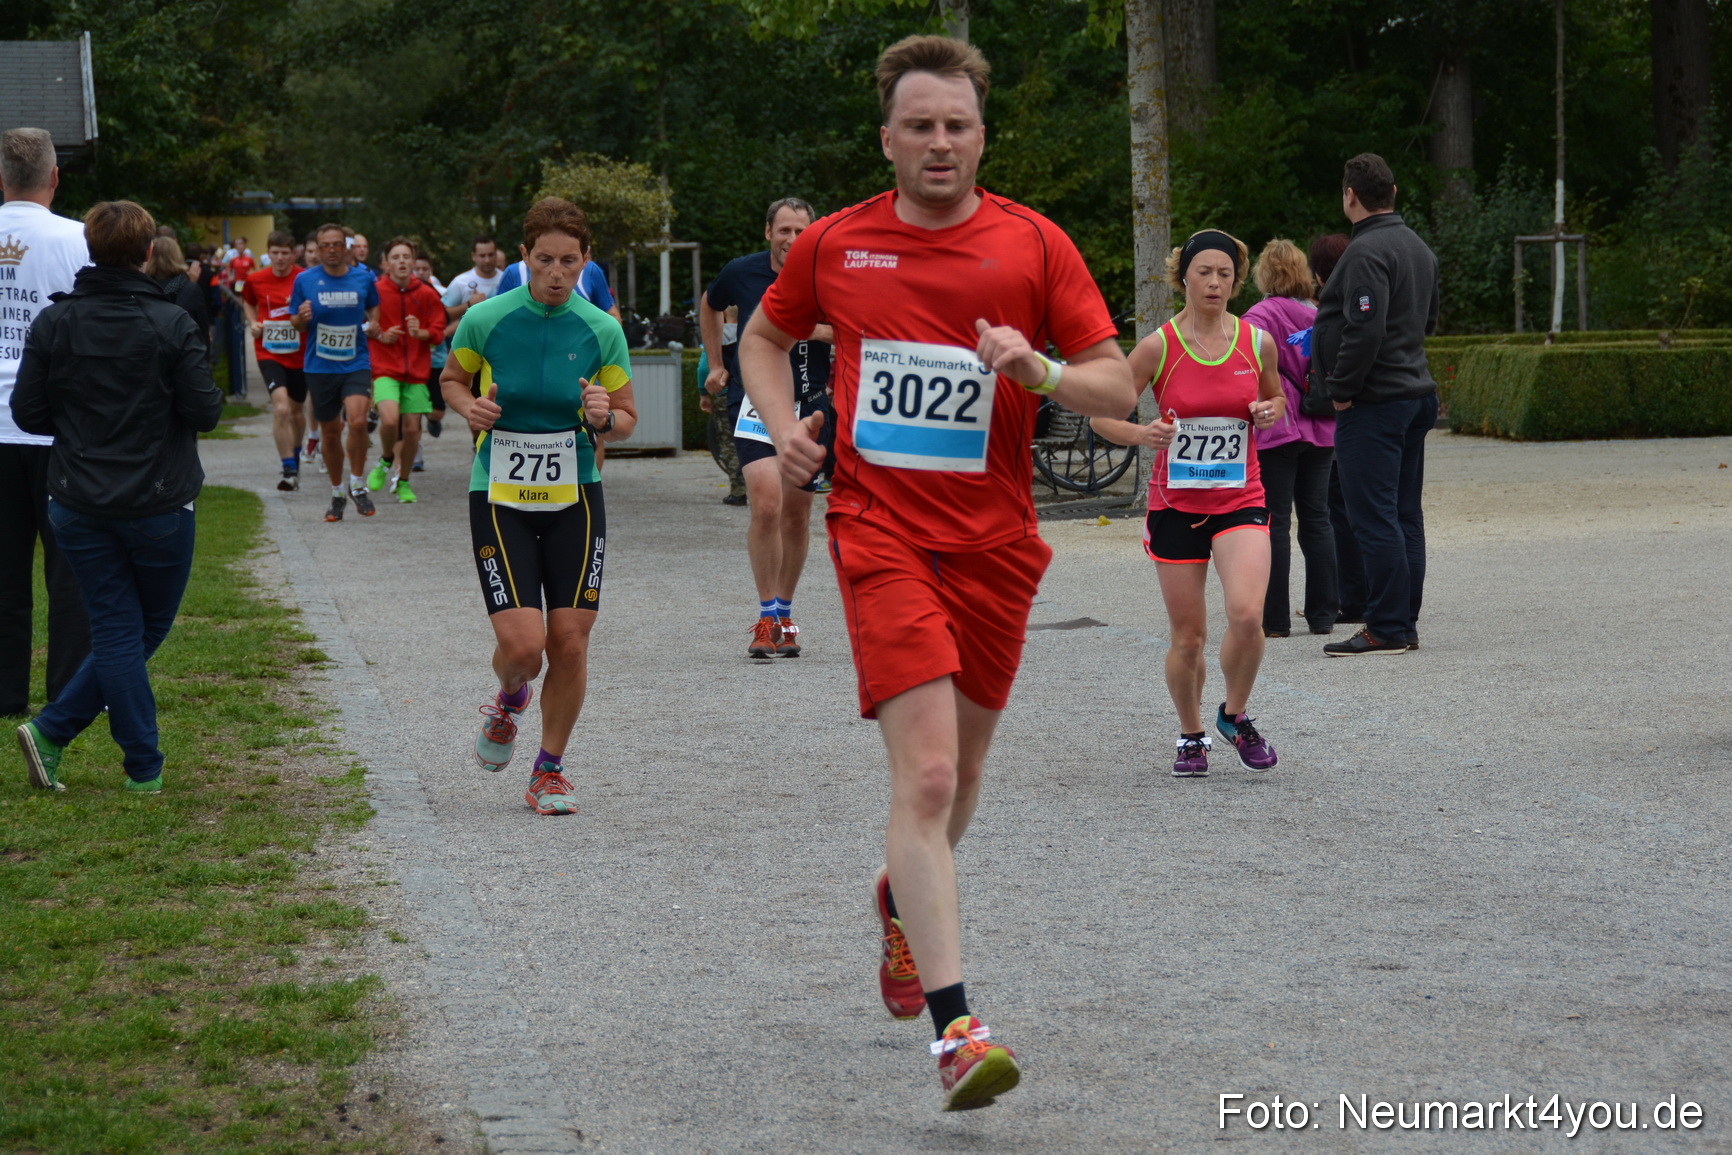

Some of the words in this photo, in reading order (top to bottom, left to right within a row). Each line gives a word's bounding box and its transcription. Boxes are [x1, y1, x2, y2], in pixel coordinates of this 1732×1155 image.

[845, 250, 869, 260] TGK
[844, 260, 897, 268] LAUFTEAM
[0, 267, 16, 280] IM
[0, 307, 31, 322] INER
[266, 328, 297, 341] 2290
[320, 332, 353, 348] 2672
[864, 350, 905, 366] PARTL
[908, 355, 973, 372] Neumarkt
[871, 370, 981, 424] 3022
[752, 423, 768, 435] Tho
[1180, 423, 1197, 432] RTL
[1198, 423, 1236, 432] Neumarkt
[493, 438, 522, 449] PARTL
[523, 441, 563, 450] Neumarkt
[1177, 433, 1242, 461] 2723
[509, 452, 561, 482] 275
[1188, 466, 1227, 478] Simone
[519, 489, 549, 501] Klara
